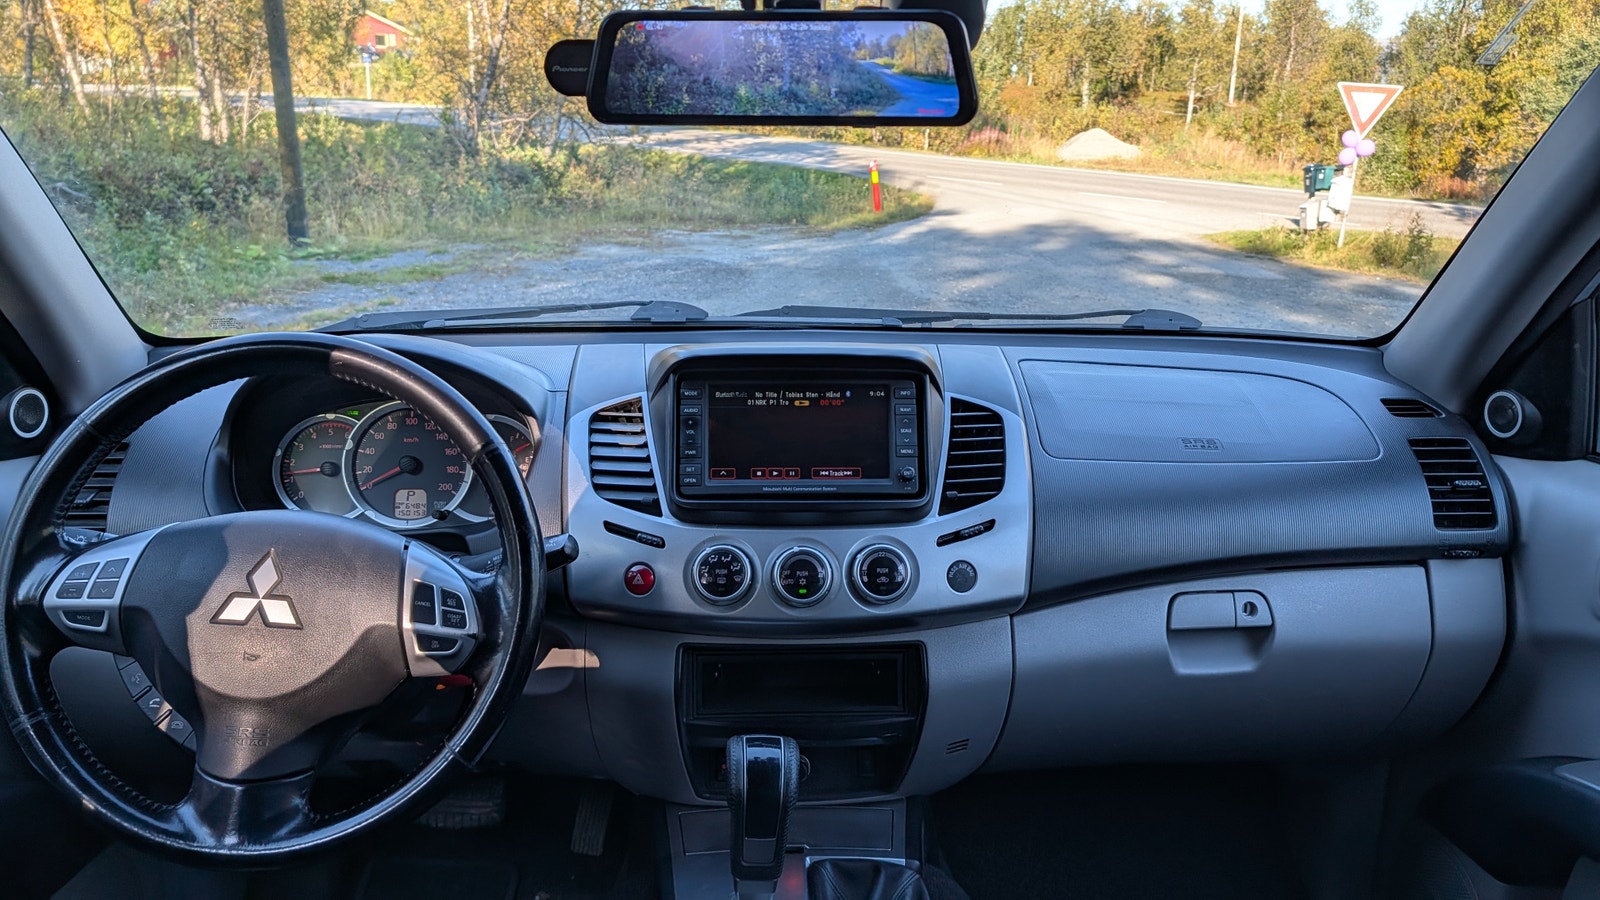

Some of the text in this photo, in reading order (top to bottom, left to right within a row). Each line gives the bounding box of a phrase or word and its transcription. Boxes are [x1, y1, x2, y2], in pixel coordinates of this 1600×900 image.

[328, 428, 333, 436] 5
[364, 447, 375, 455] 40
[407, 490, 416, 501] P
